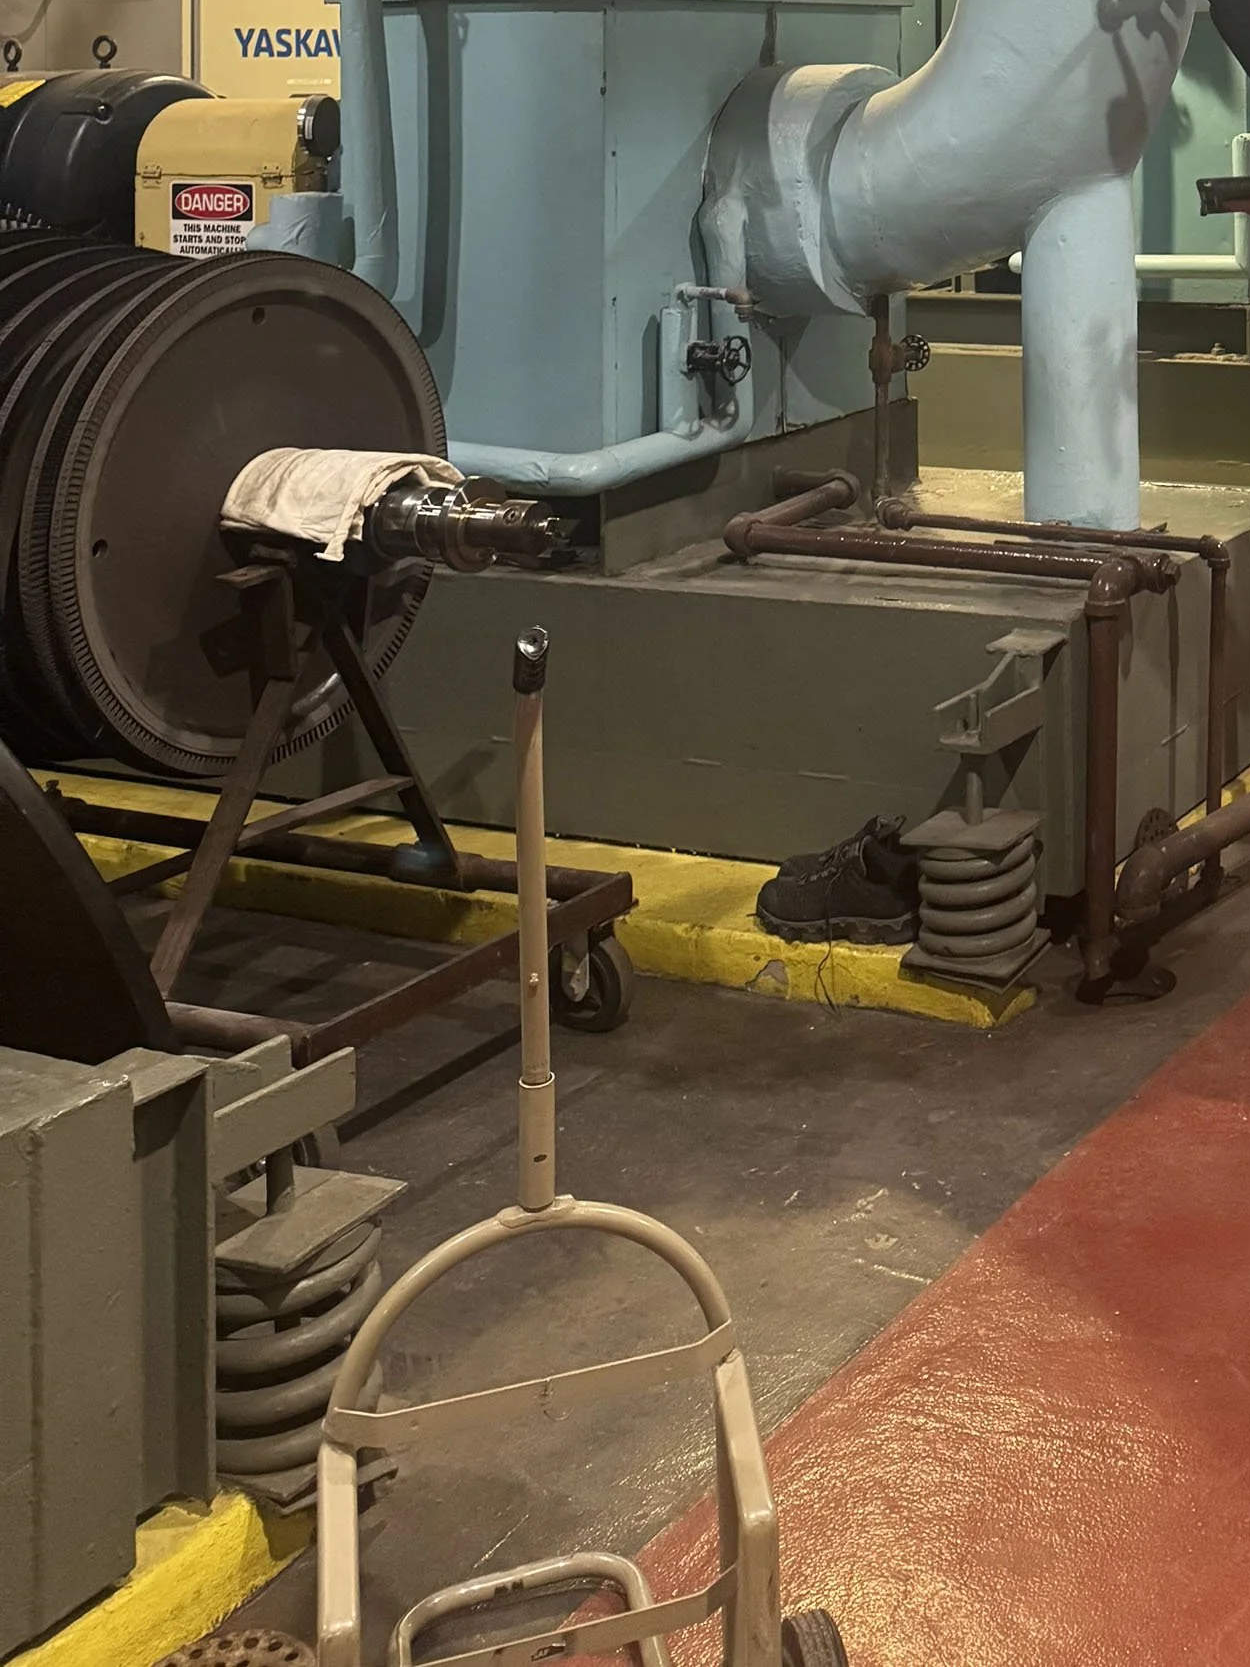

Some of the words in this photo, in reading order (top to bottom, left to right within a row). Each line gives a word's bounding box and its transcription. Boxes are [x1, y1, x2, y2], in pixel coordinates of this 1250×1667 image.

[234, 28, 340, 57] YASKA
[181, 193, 244, 212] DANGER
[183, 224, 201, 232] THIS
[203, 224, 241, 233] MACHINE
[173, 235, 203, 243] STARTS
[205, 235, 222, 244] AND
[224, 236, 247, 245] STOP
